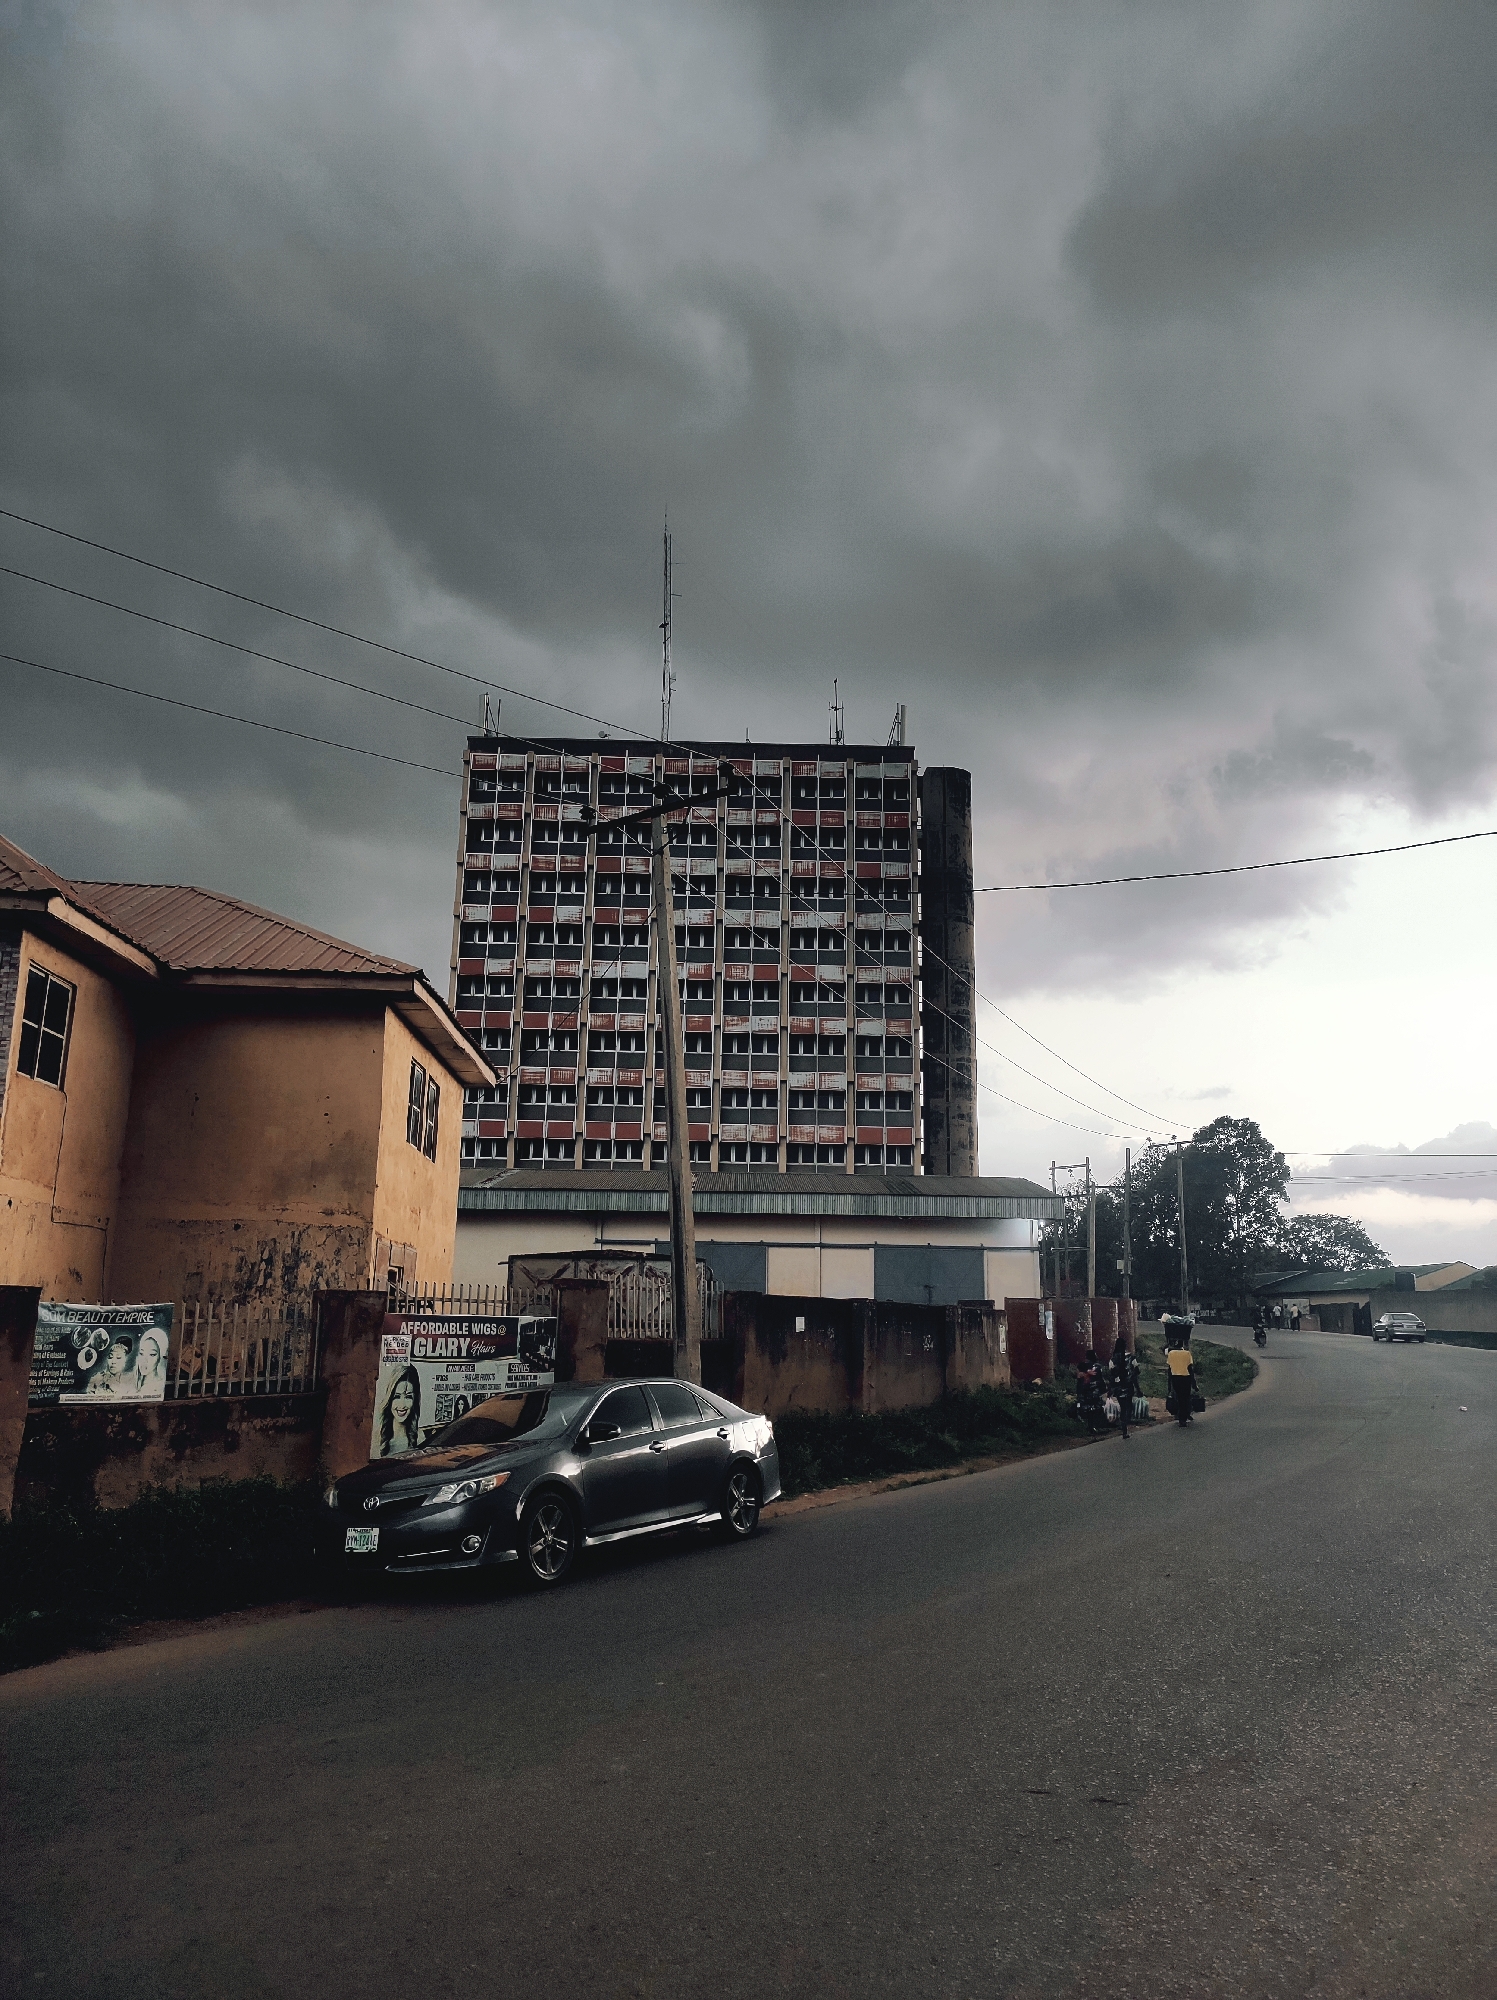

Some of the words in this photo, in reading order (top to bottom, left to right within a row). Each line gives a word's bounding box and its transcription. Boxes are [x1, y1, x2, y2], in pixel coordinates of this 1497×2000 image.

[67, 1311, 116, 1323] BEAUTY
[116, 1311, 155, 1323] EMPIRE
[399, 1321, 469, 1335] AFFORDABLE
[413, 1337, 470, 1357] GLARY
